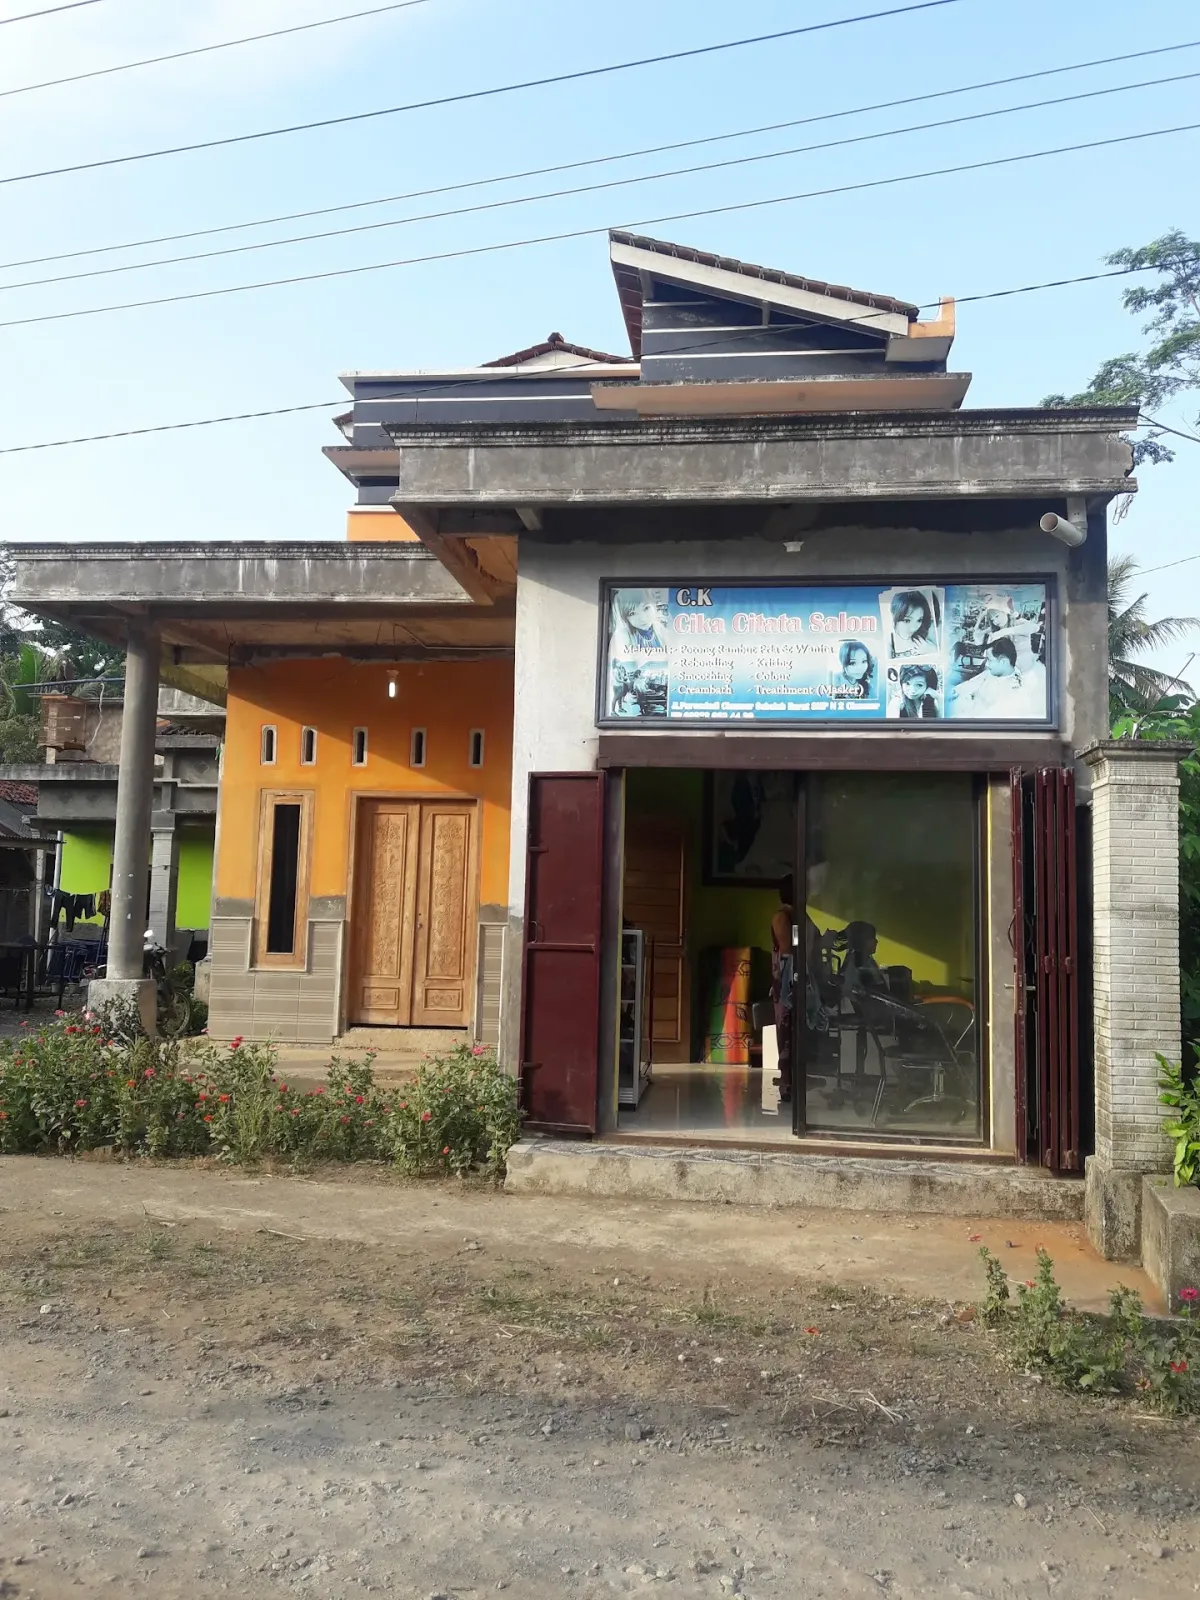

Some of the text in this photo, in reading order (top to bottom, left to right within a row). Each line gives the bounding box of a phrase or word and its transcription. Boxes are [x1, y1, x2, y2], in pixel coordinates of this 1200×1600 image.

[676, 588, 712, 606] C.K
[673, 611, 877, 634] Cika Citata Salon
[678, 683, 734, 696] Creambath
[754, 683, 814, 696] Treathment
[816, 683, 865, 697] (Masker)
